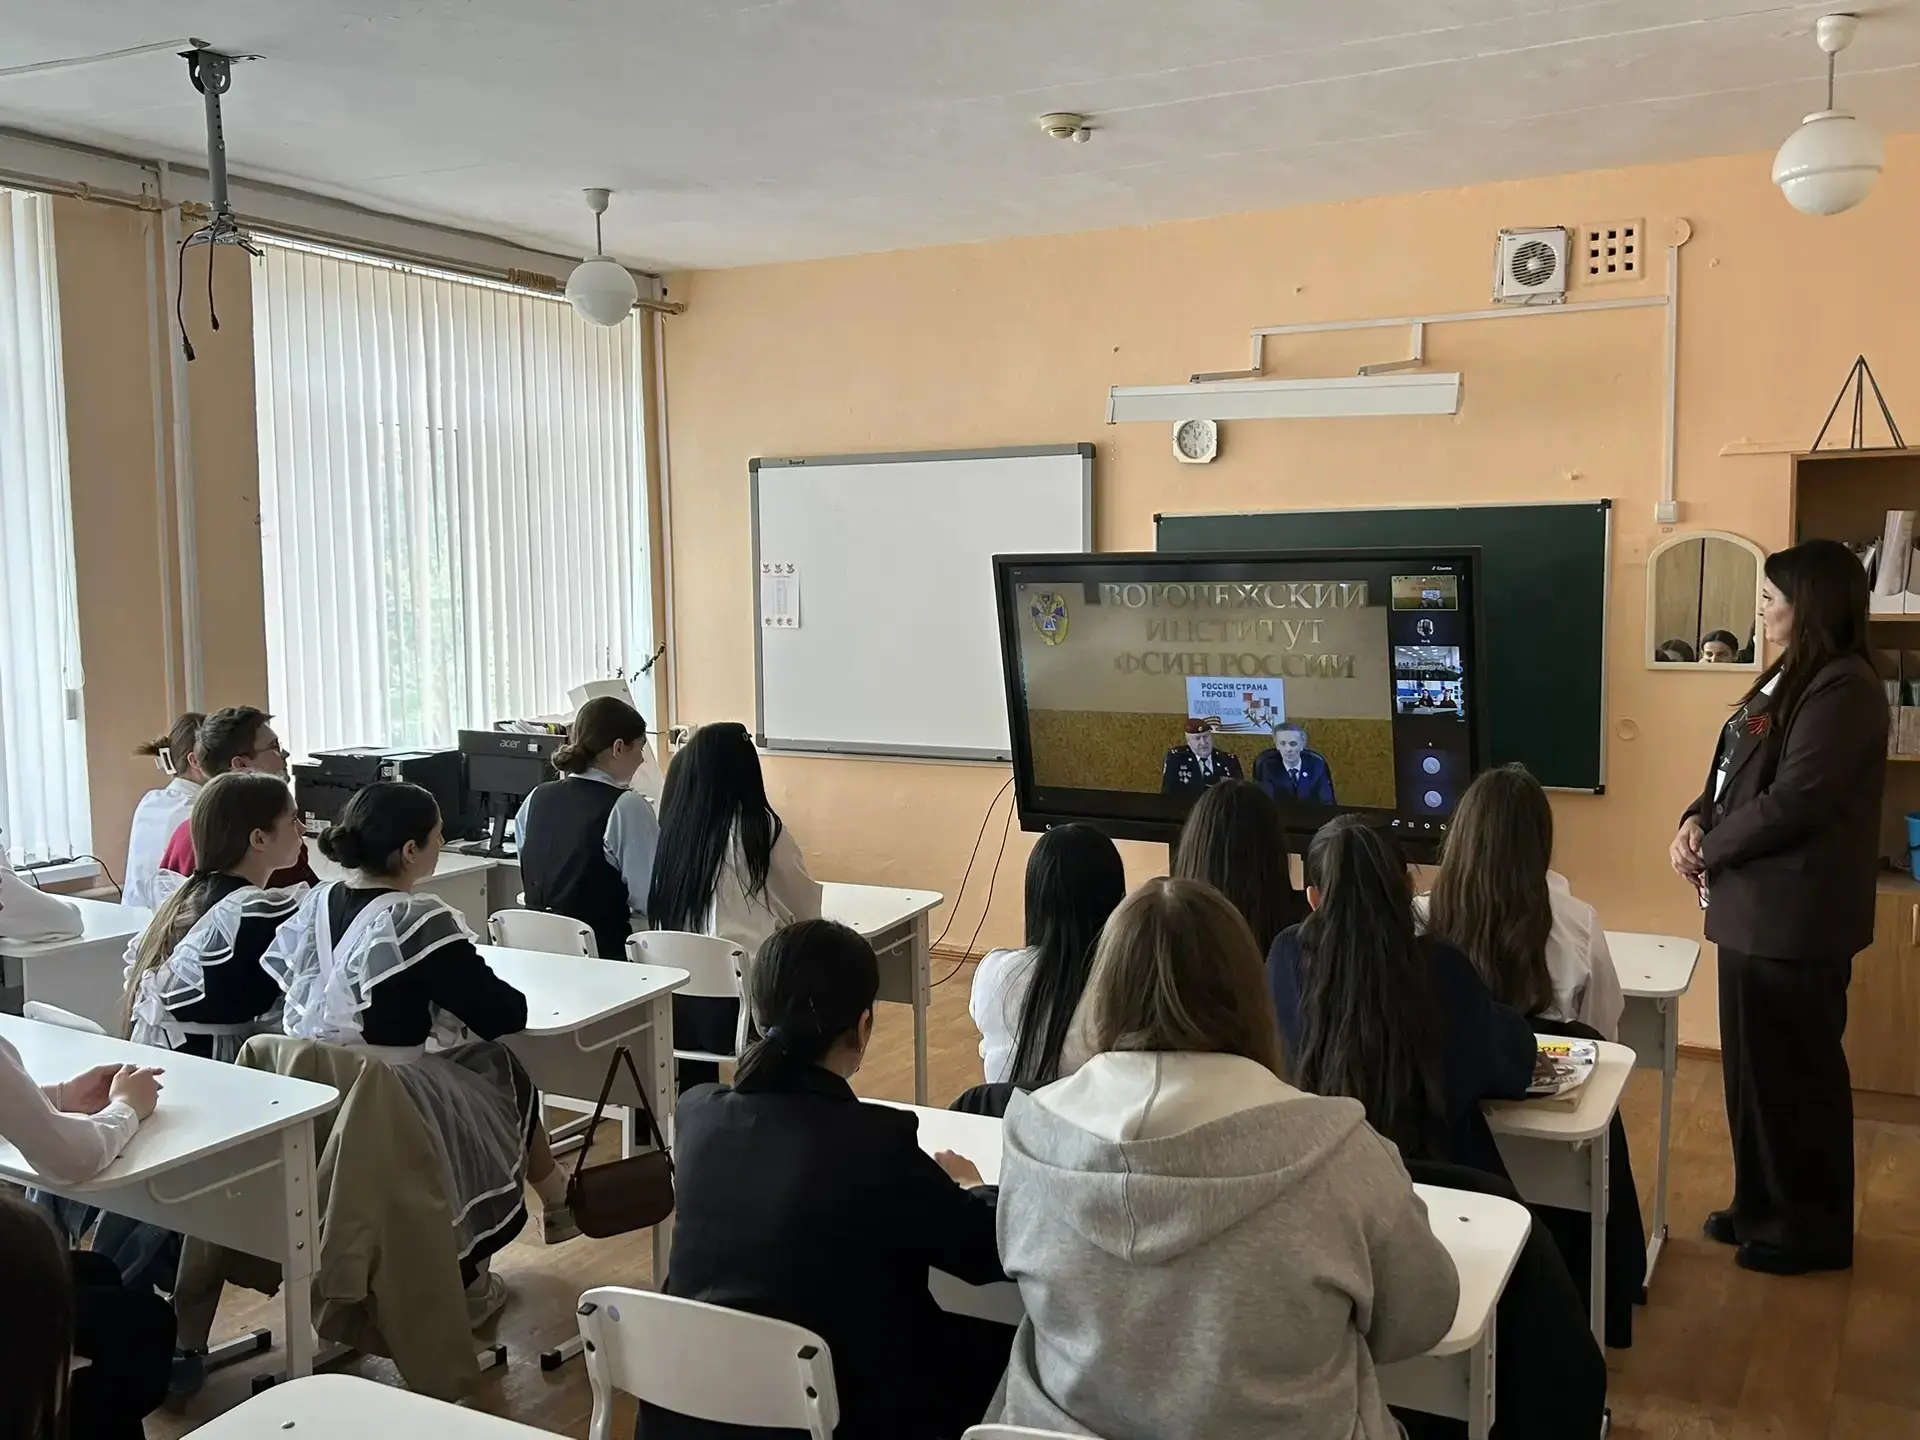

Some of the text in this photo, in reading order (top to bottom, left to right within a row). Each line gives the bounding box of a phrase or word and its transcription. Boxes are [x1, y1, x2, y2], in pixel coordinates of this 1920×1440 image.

[1144, 618, 1326, 651] ИНСТИТУТ
[1113, 651, 1357, 678] ФСИН РОССИИ
[1201, 682, 1268, 691] РОССИЯ СТРАНА
[1201, 690, 1236, 698] ГЕРОЕВ!
[499, 739, 521, 749] acer
